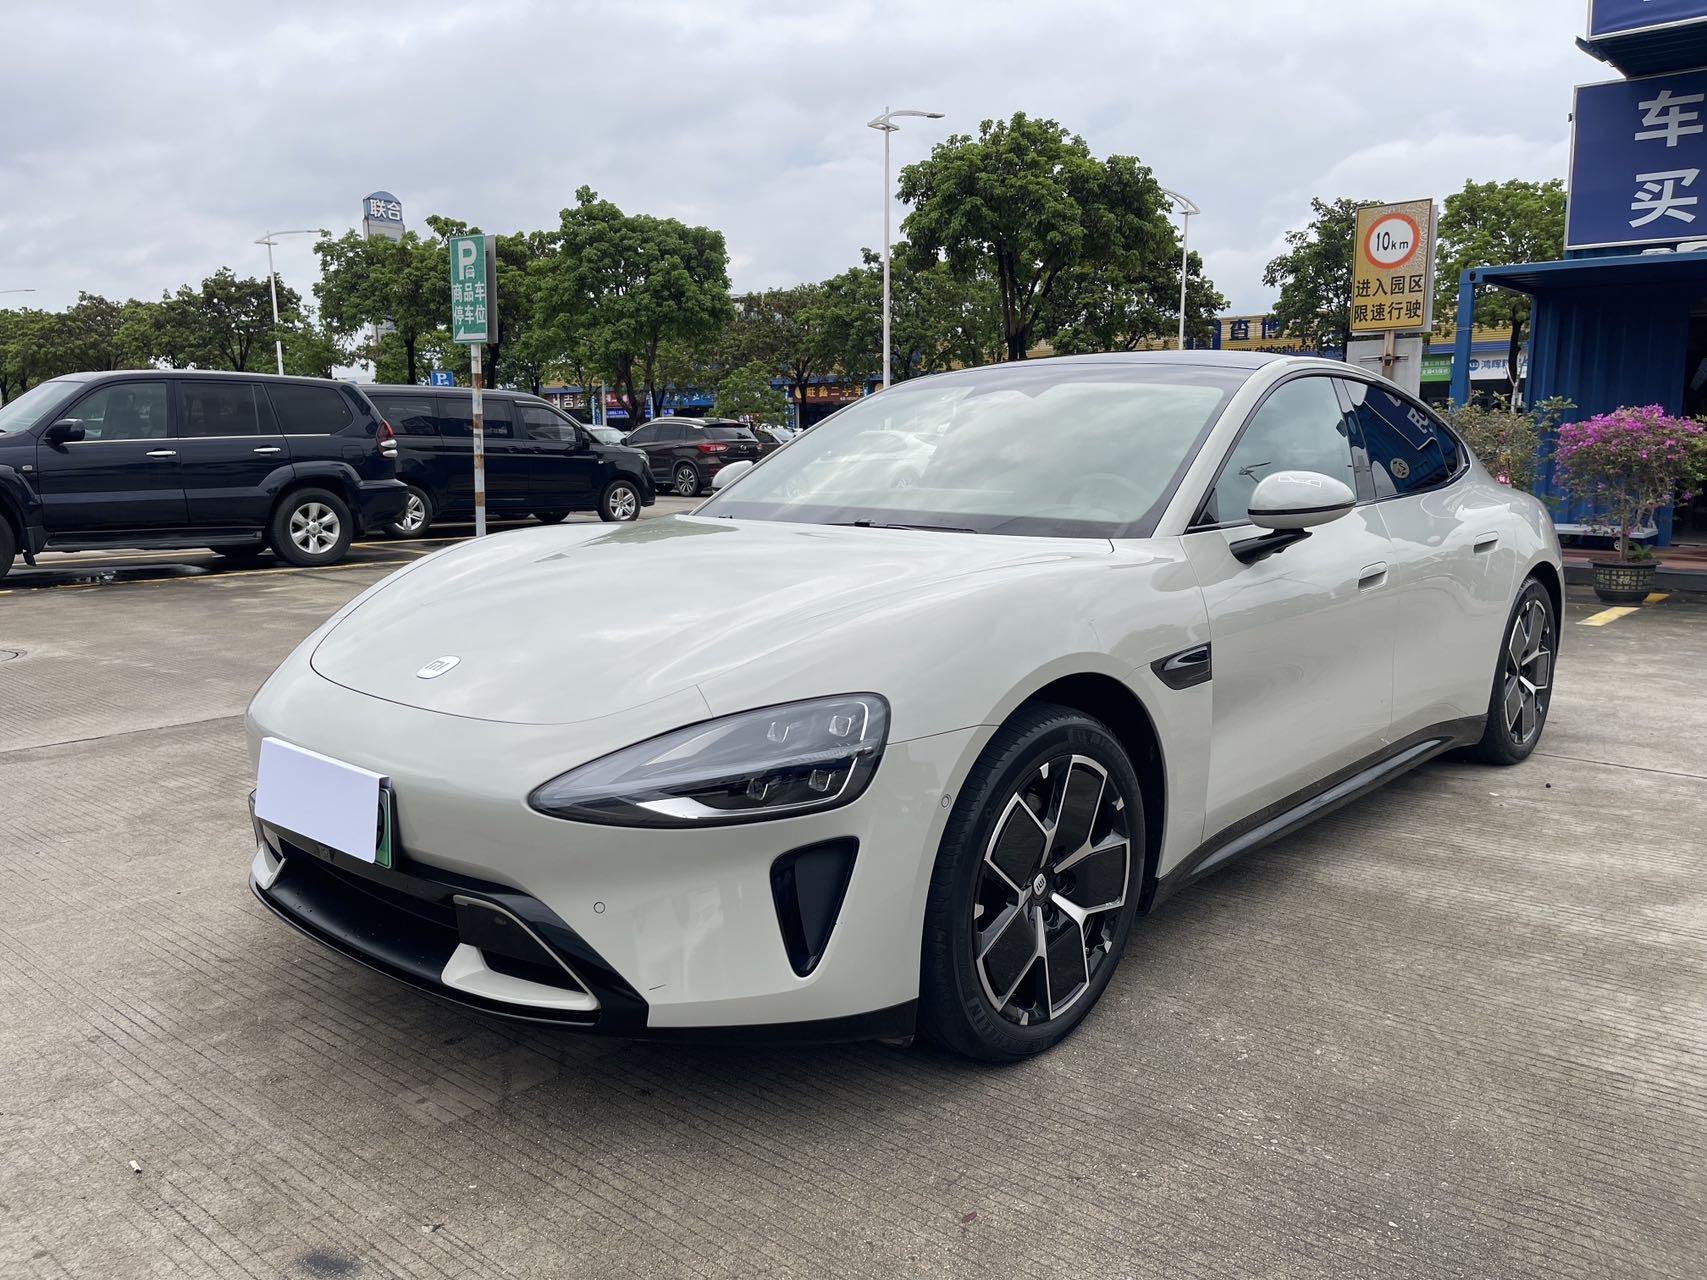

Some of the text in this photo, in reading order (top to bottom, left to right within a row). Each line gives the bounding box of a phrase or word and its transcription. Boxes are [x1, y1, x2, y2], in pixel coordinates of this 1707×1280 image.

[1634, 90, 1705, 147] 车
[1628, 168, 1700, 228] 买
[370, 199, 401, 221] 联合
[452, 281, 485, 303] 商品车
[1355, 274, 1424, 298] 进入园区
[454, 304, 486, 325] 停车位
[1353, 300, 1422, 323] 限速行驶
